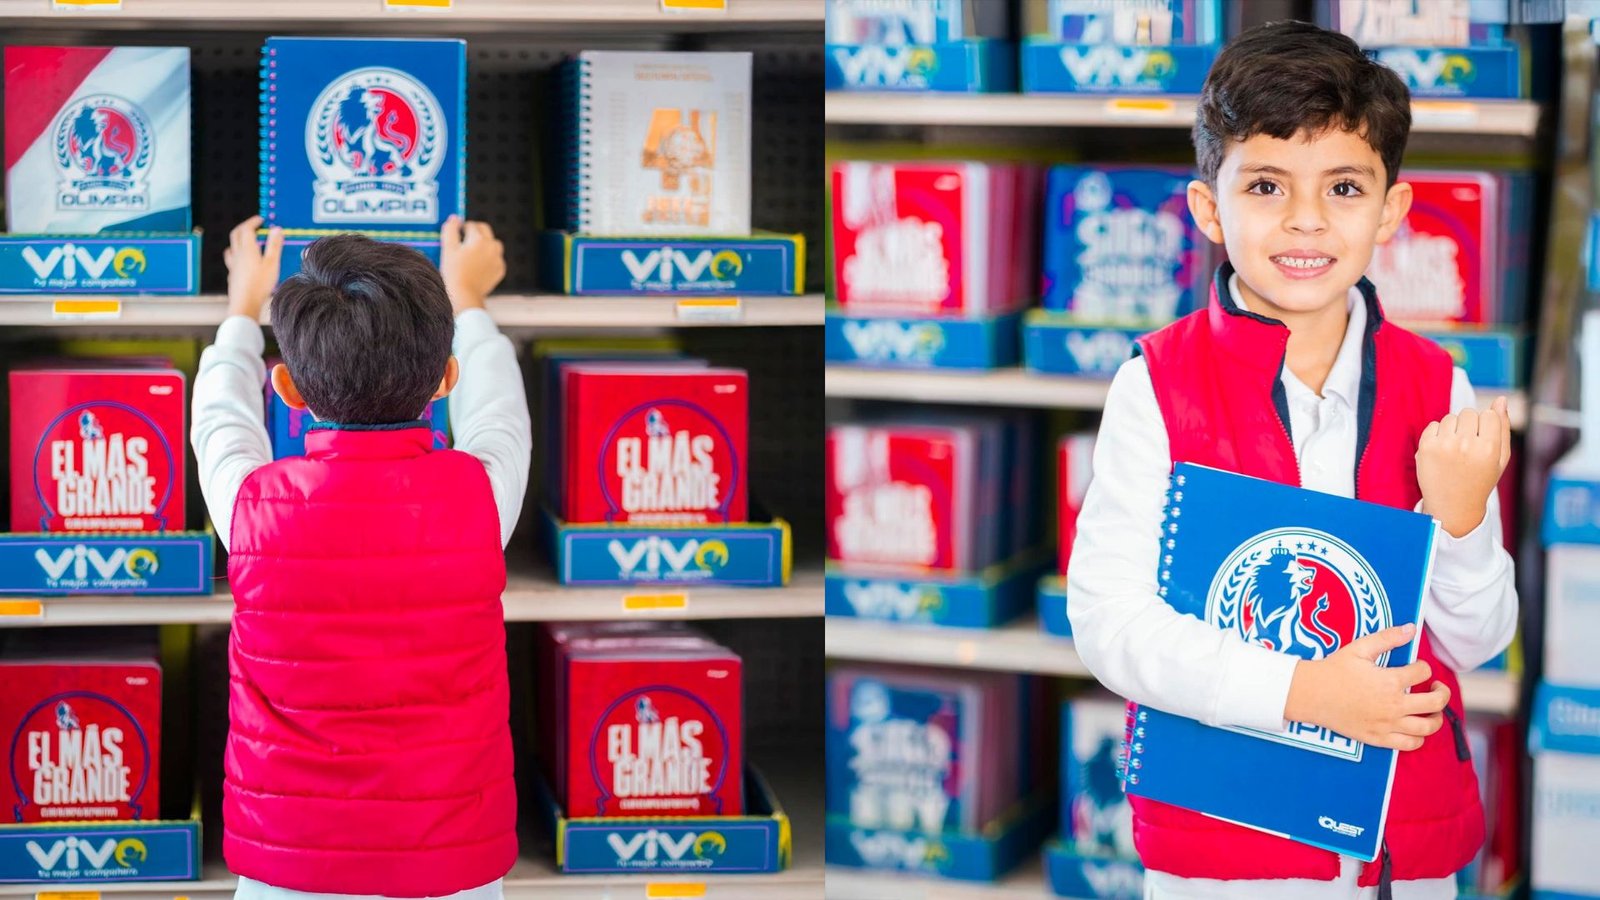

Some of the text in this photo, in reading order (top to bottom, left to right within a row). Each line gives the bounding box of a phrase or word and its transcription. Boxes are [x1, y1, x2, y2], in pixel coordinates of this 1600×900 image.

[62, 194, 144, 206] OLIMPIA
[323, 198, 428, 213] OLIMPIA
[52, 433, 149, 480] EL MÁS
[616, 430, 714, 476] EL MÁS
[57, 475, 156, 517] GRANDE
[622, 472, 720, 512] GRANDE
[28, 723, 124, 770] EL MÁS
[607, 716, 704, 762] EL MÁS
[33, 765, 131, 806] GRANDE
[613, 757, 713, 798] GRANDE
